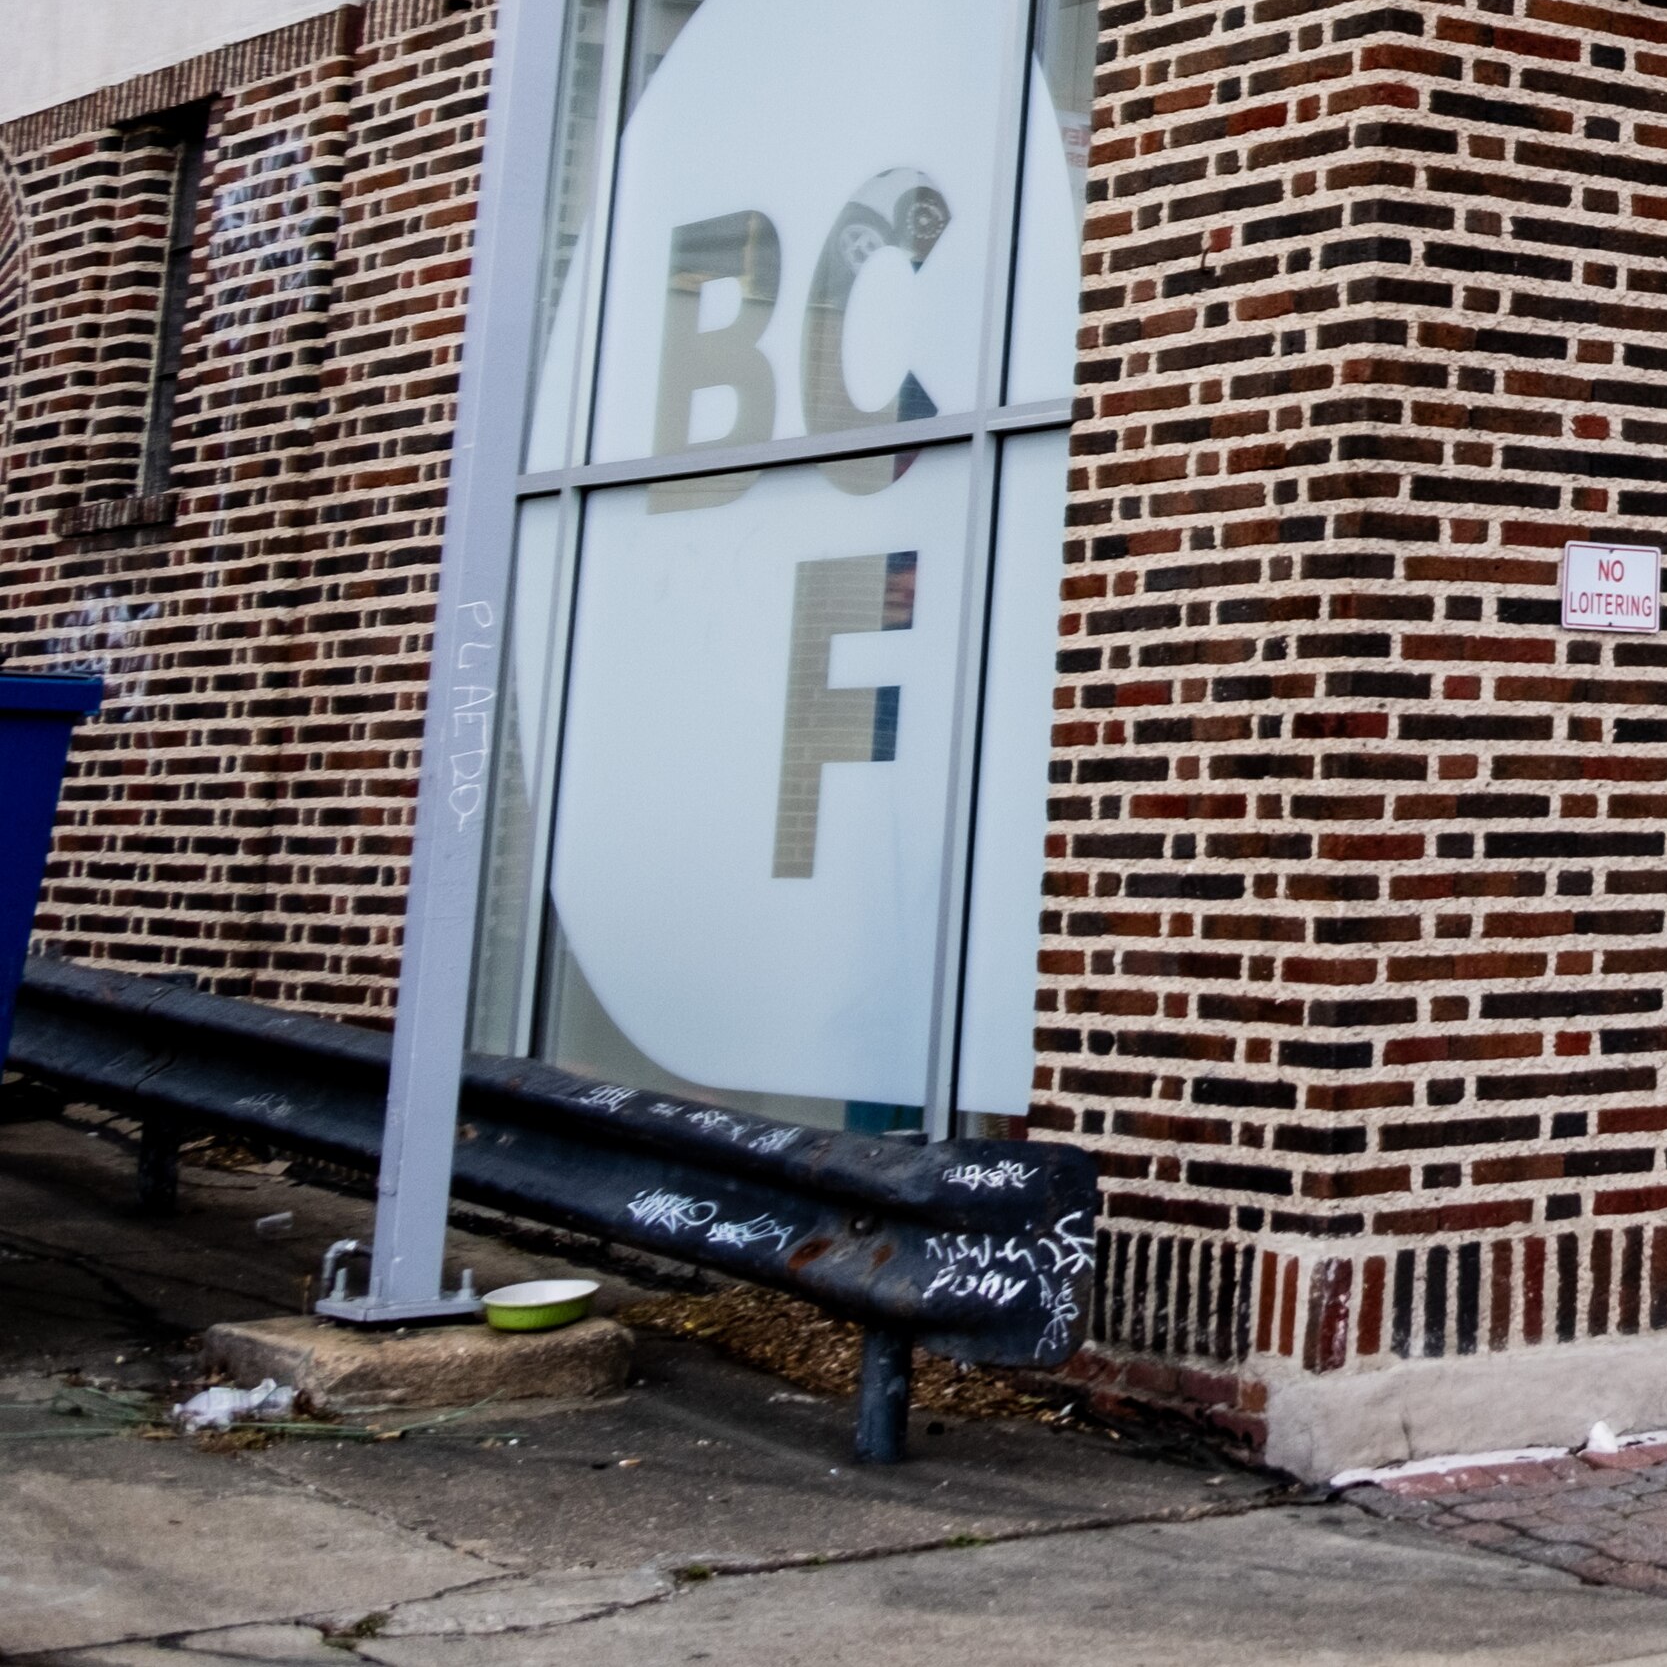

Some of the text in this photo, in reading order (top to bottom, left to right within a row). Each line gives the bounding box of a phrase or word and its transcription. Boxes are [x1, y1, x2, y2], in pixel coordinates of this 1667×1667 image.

[646, 166, 952, 516] BC
[1570, 591, 1652, 618] LOITERING
[1598, 559, 1625, 583] NO
[771, 550, 918, 879] F
